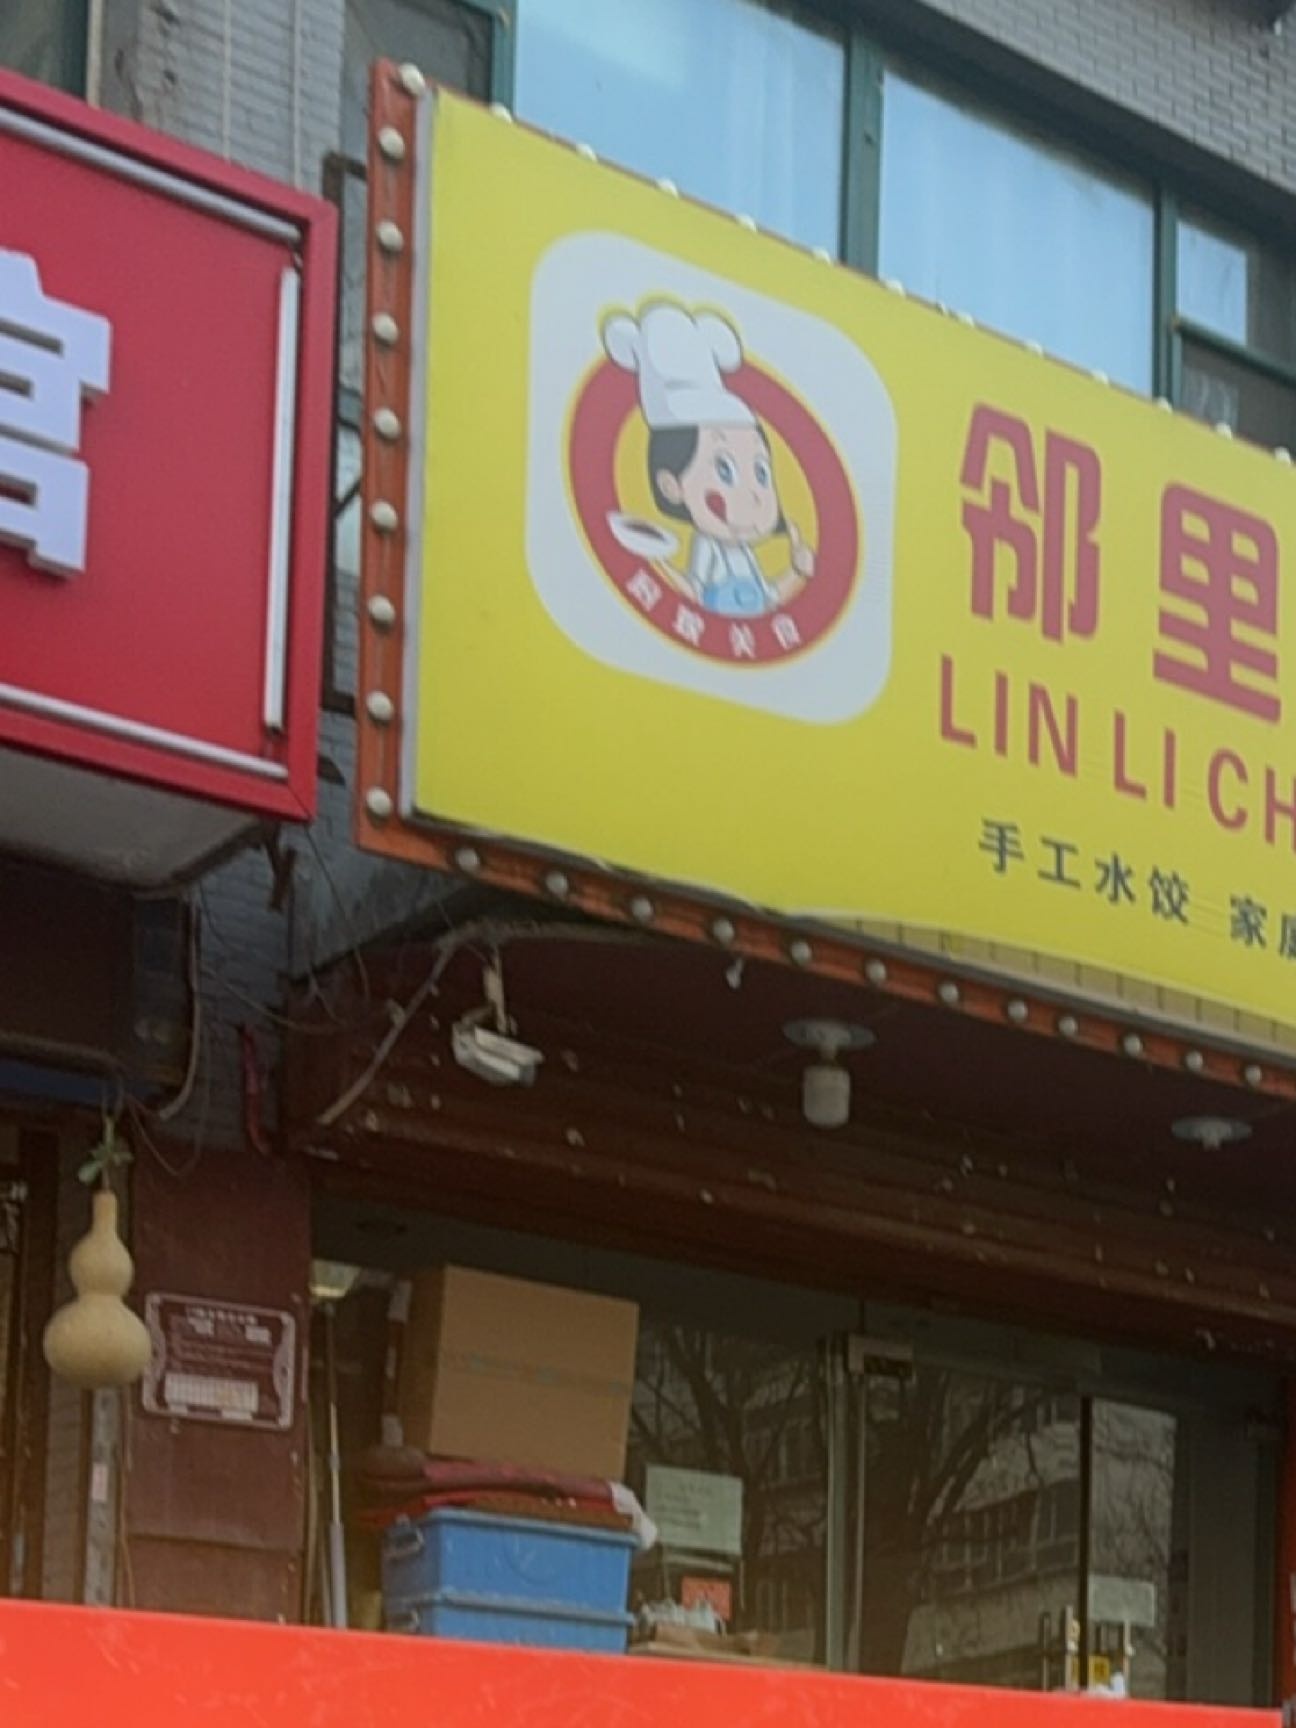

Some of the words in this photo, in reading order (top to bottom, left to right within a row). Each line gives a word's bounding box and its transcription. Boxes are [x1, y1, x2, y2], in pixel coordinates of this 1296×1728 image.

[940, 655, 1079, 776] LIN
[1113, 711, 1176, 809] LI
[979, 818, 1190, 924] 手工水饺
